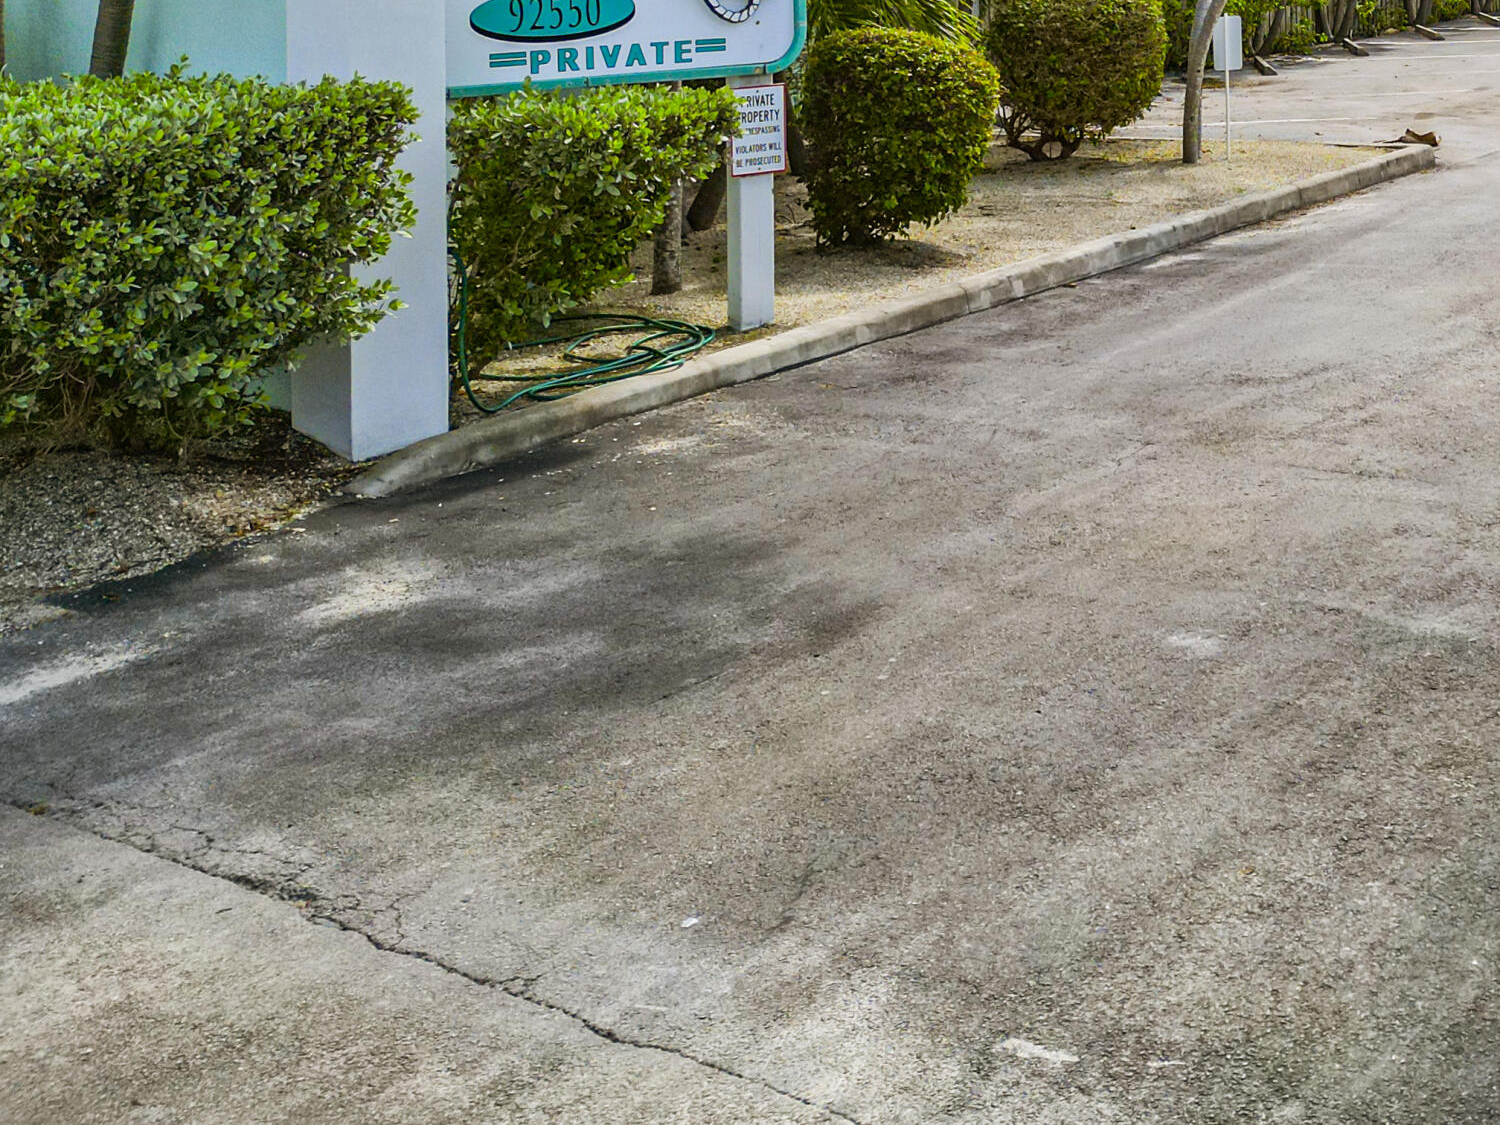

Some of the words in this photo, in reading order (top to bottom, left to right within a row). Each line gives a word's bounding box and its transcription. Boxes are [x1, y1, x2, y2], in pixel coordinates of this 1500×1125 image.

[530, 39, 692, 74] PRIVATE
[741, 109, 779, 123] ROPERTY
[736, 143, 766, 154] VIOLATORS
[768, 142, 781, 150] WILL
[736, 159, 743, 167] BE
[745, 155, 781, 166] PROSECUTED
